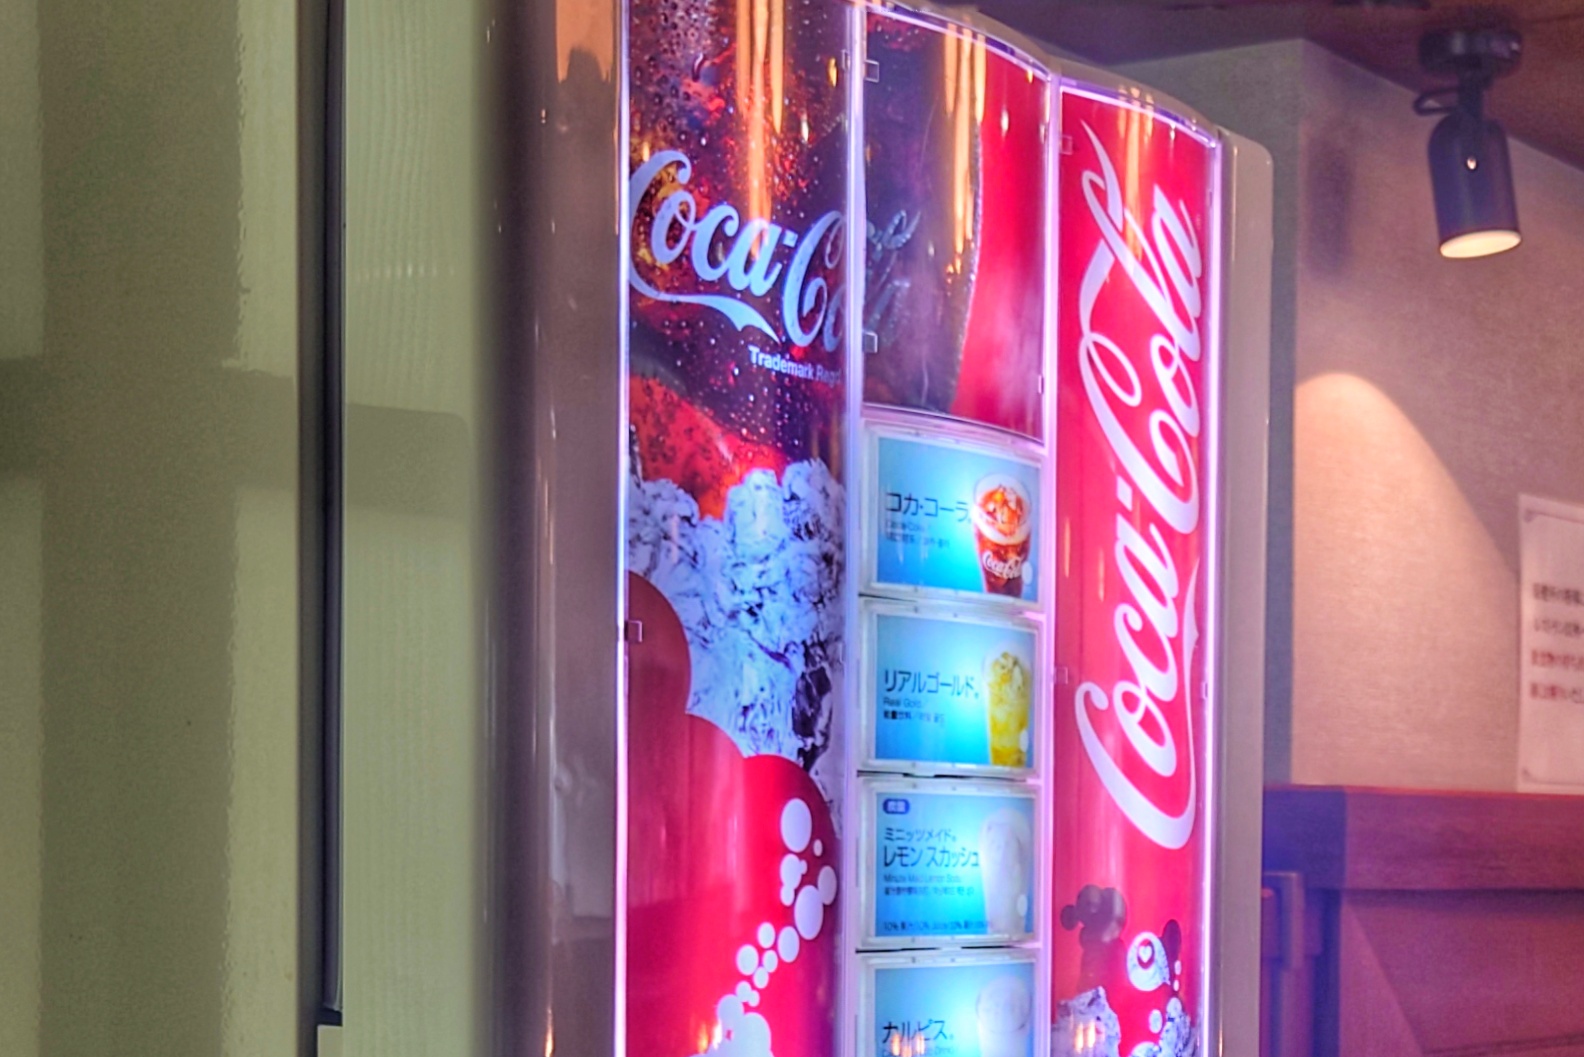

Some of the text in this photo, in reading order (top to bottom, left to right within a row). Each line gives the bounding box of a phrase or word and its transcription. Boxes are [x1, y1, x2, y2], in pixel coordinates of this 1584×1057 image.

[747, 344, 814, 380] Trademark
[1075, 119, 1201, 849] Coca-Cola
[884, 669, 976, 698] リアルゴールド
[884, 845, 979, 868] レモンスカッシュ
[883, 1019, 947, 1044] カルピス
